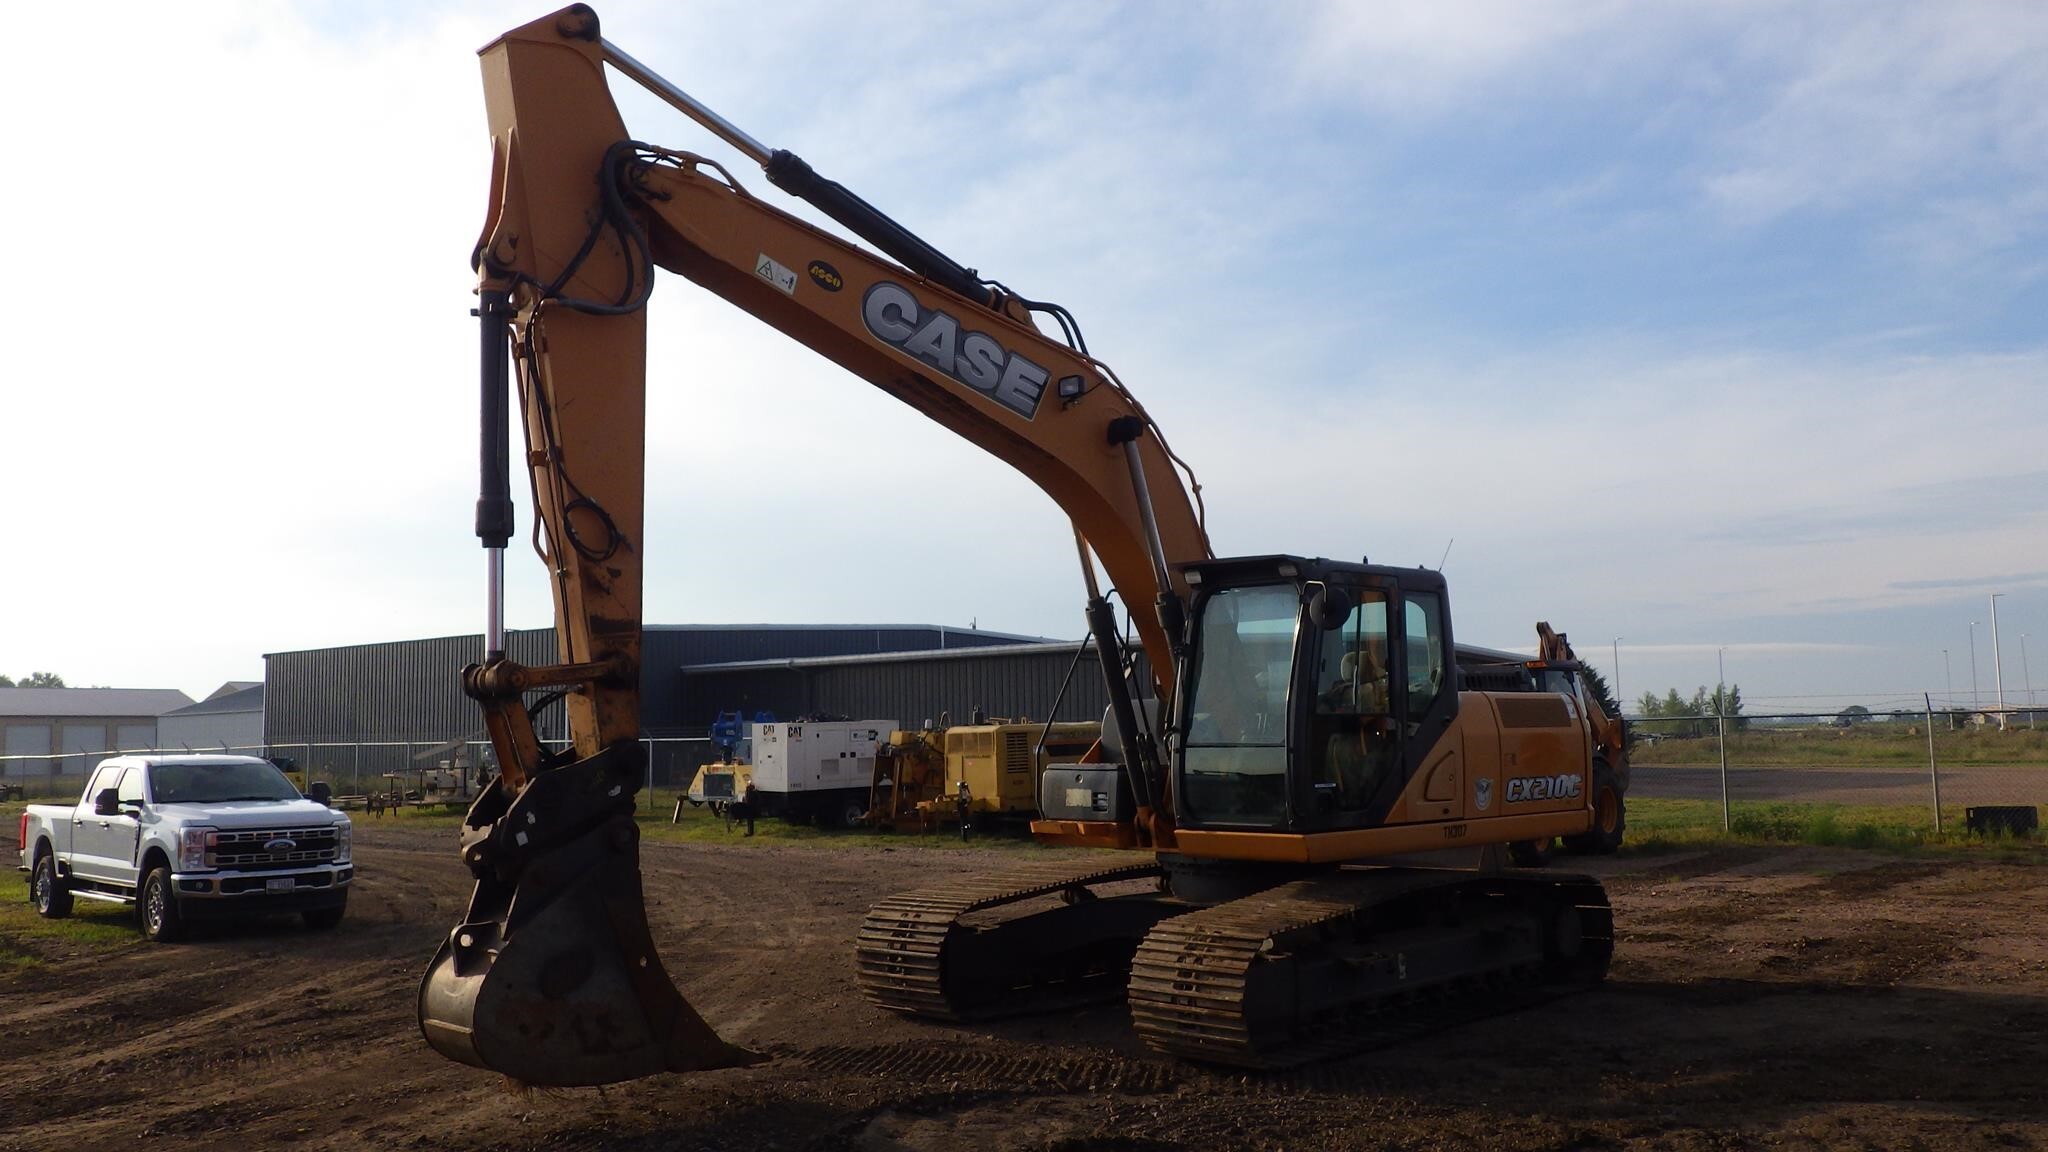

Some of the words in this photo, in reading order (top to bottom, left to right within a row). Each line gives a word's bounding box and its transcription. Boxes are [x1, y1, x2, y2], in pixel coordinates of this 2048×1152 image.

[865, 282, 1048, 415] CASE
[763, 724, 775, 736] CAT
[788, 726, 803, 738] CAT
[1506, 774, 1583, 803] CX210C
